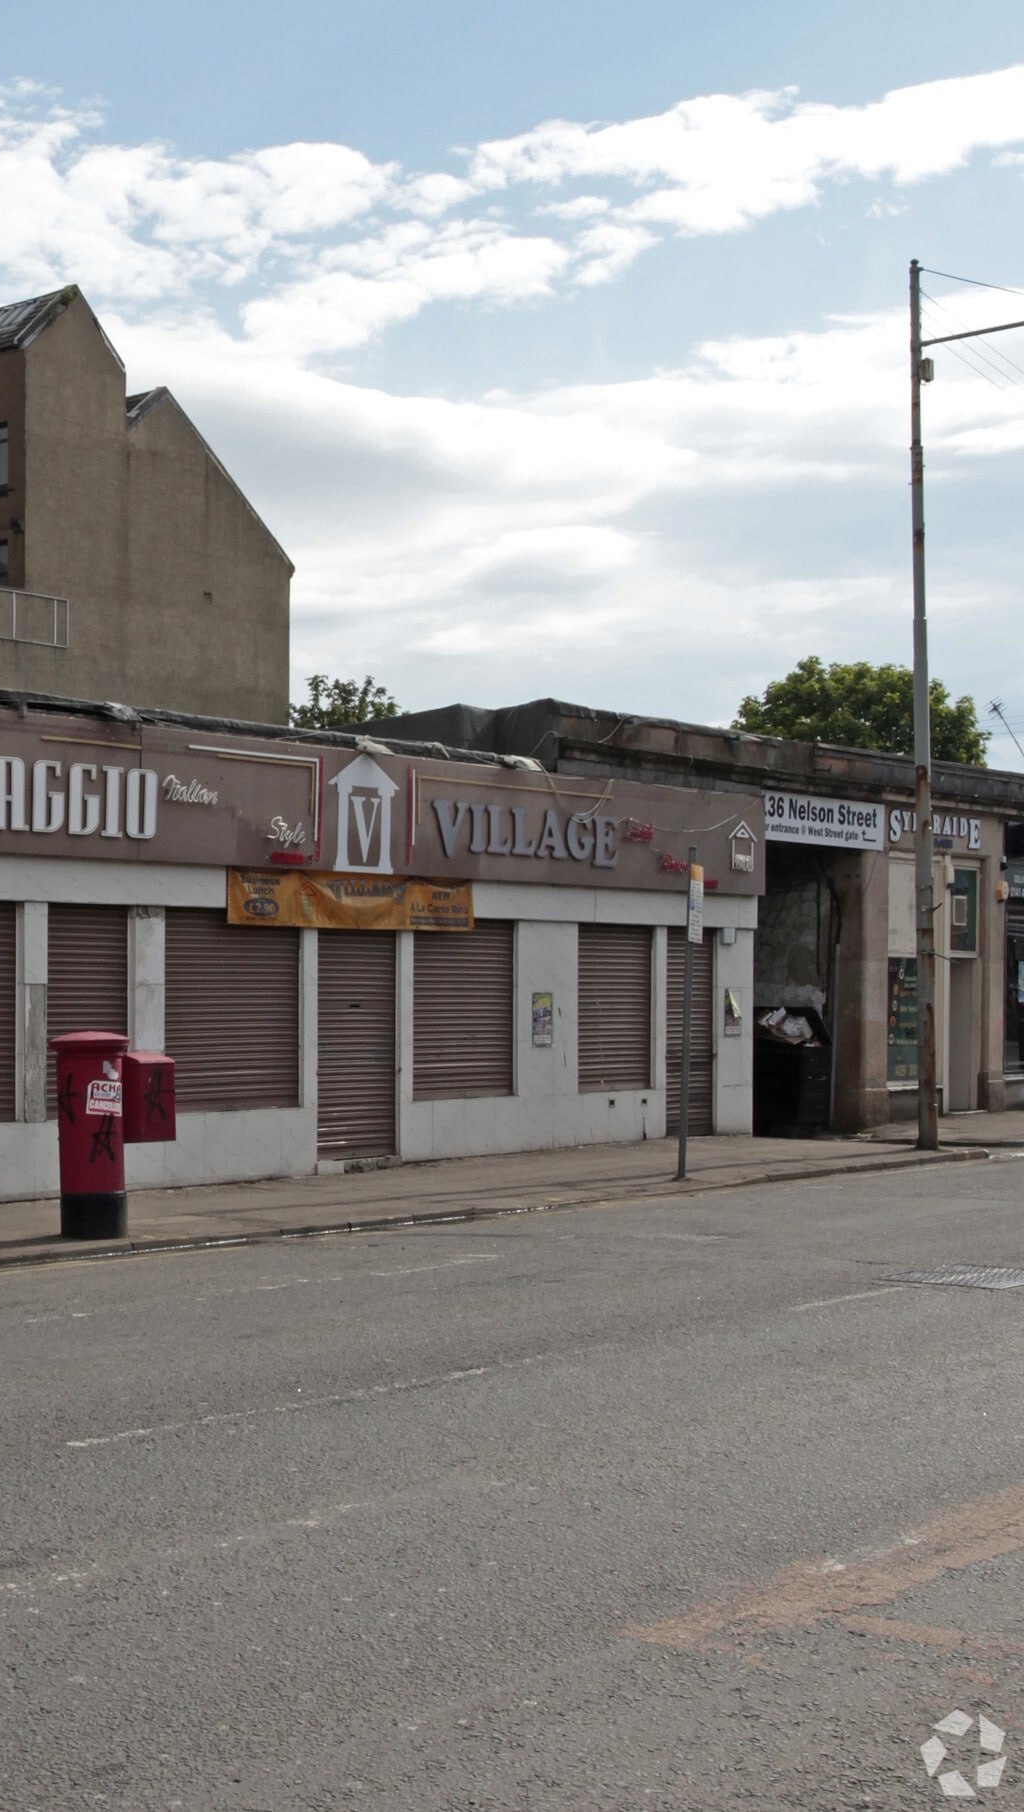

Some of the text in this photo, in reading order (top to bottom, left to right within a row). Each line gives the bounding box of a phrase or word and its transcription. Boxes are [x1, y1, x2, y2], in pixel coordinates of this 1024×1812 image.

[788, 798, 835, 824] Nelson
[837, 804, 878, 829] Street
[266, 816, 306, 848] Style
[432, 799, 619, 869] VILLAGE
[770, 822, 800, 835] entrance
[807, 825, 824, 837] West
[824, 827, 844, 840] Street
